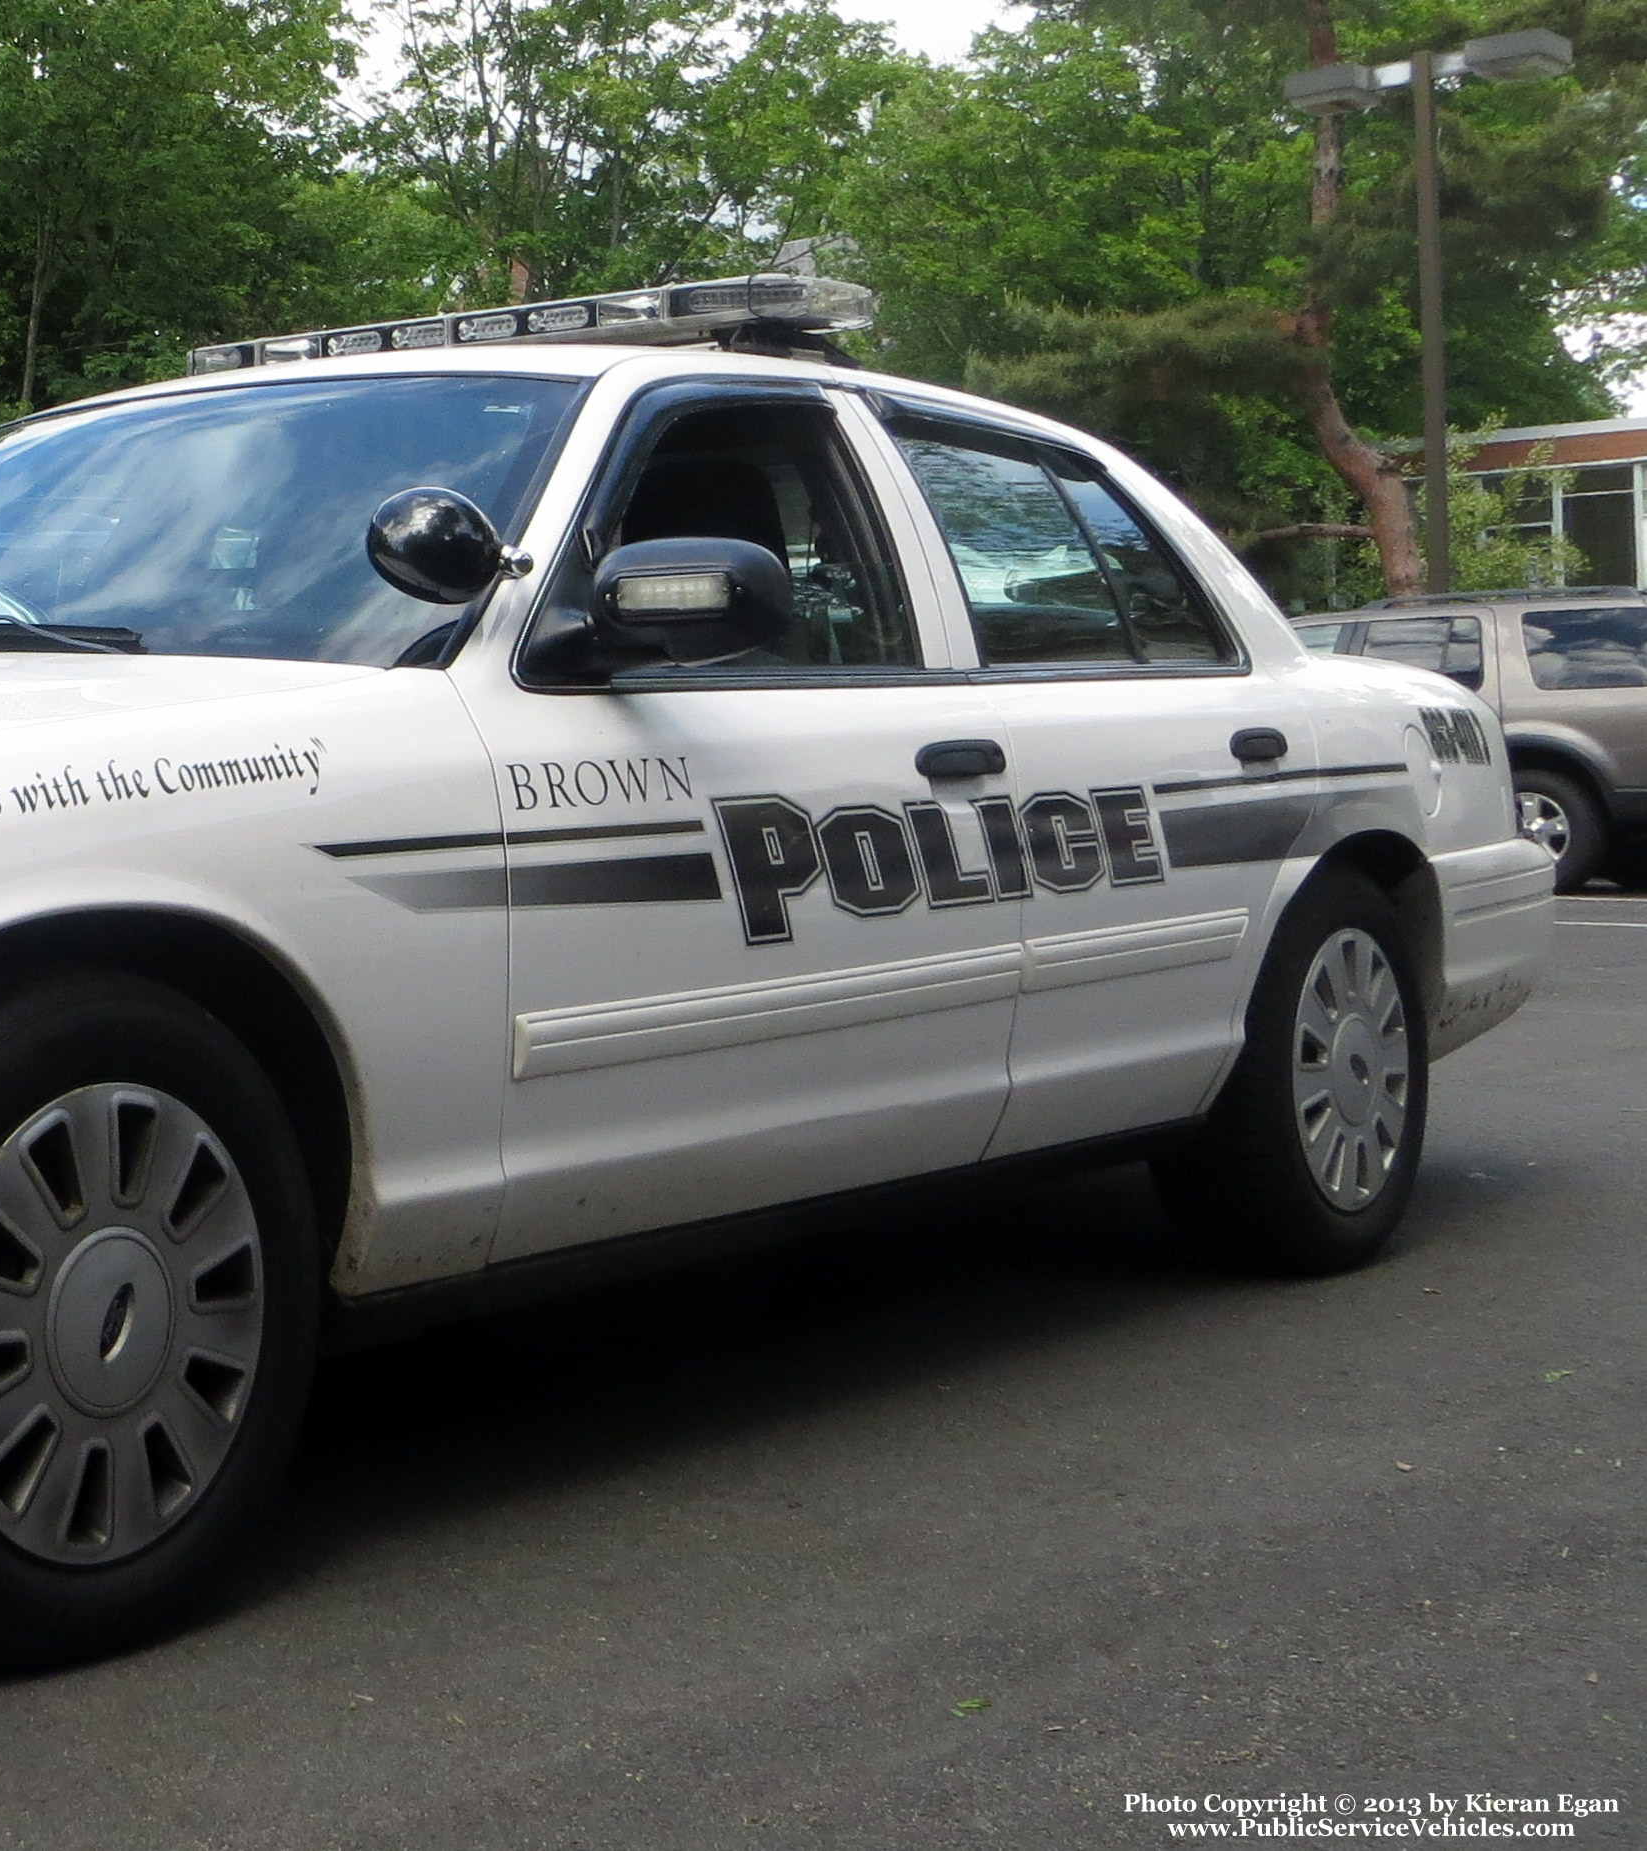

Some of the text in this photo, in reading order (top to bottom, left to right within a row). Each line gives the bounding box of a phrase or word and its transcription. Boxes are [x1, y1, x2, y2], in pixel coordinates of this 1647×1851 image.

[9, 765, 91, 815] with
[96, 759, 150, 803] the
[154, 736, 328, 797] Community"
[505, 756, 694, 810] BROWN
[712, 785, 1164, 946] POLICE
